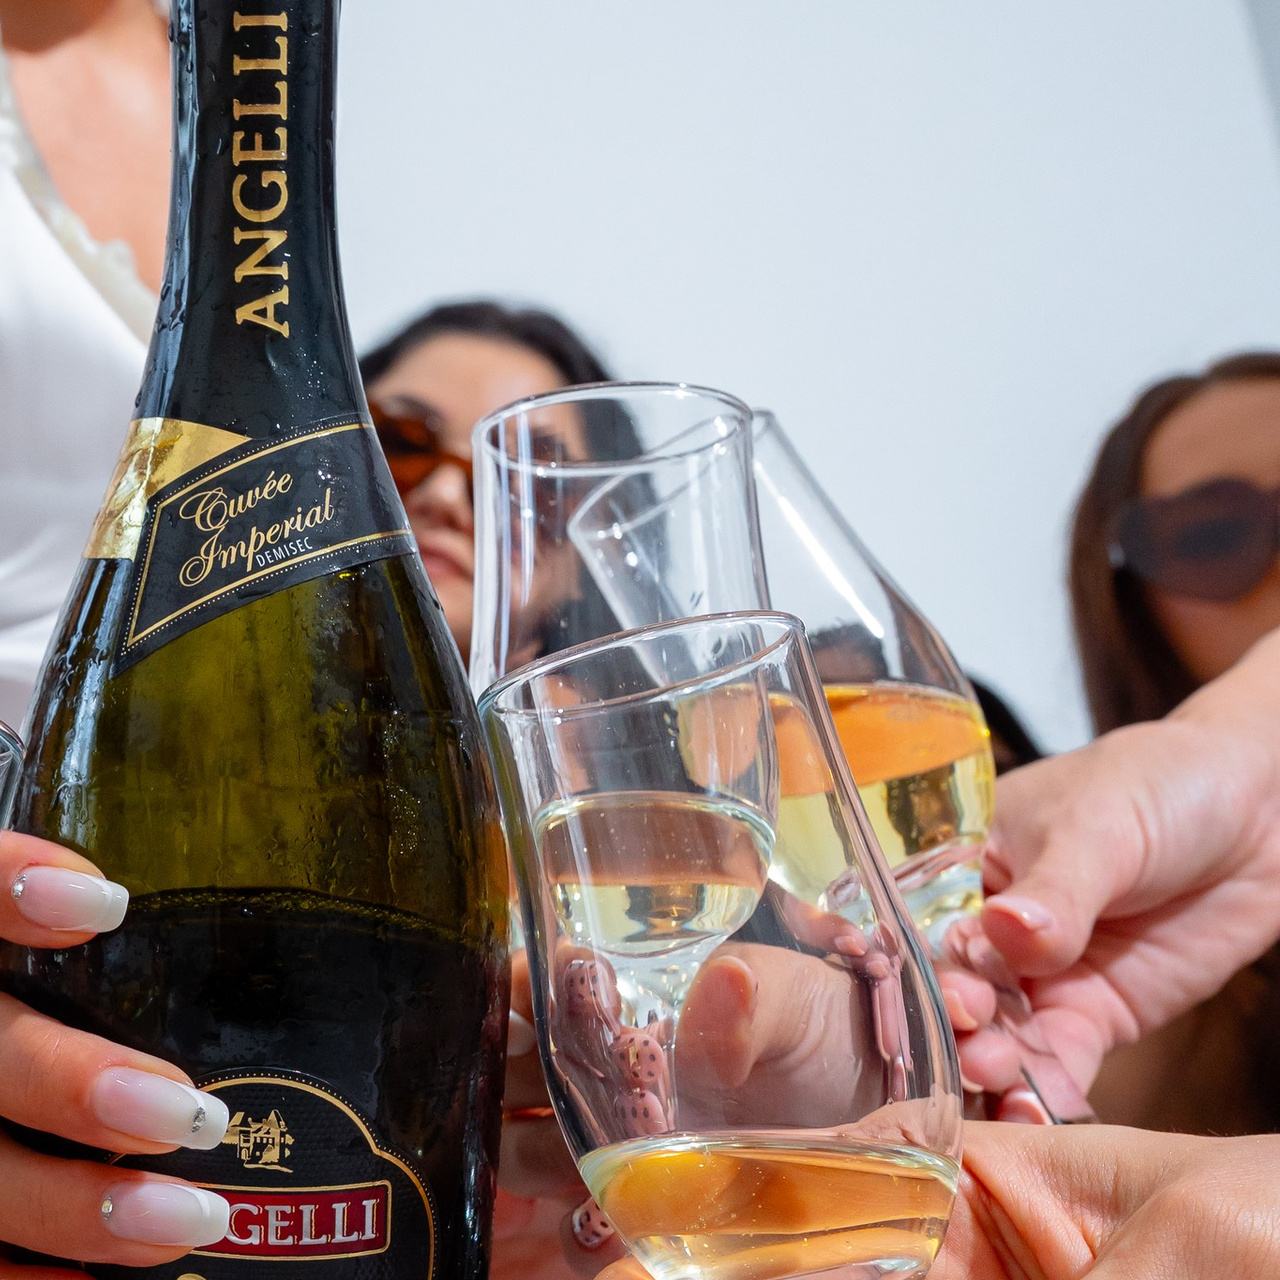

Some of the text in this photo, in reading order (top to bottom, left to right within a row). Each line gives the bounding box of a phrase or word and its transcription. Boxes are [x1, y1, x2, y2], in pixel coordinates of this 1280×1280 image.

[232, 10, 290, 339] ANGELLI
[179, 470, 294, 532] Cuvée
[178, 487, 335, 588] Imperial
[255, 536, 314, 568] DEMISEC
[225, 1198, 380, 1246] GELLI
